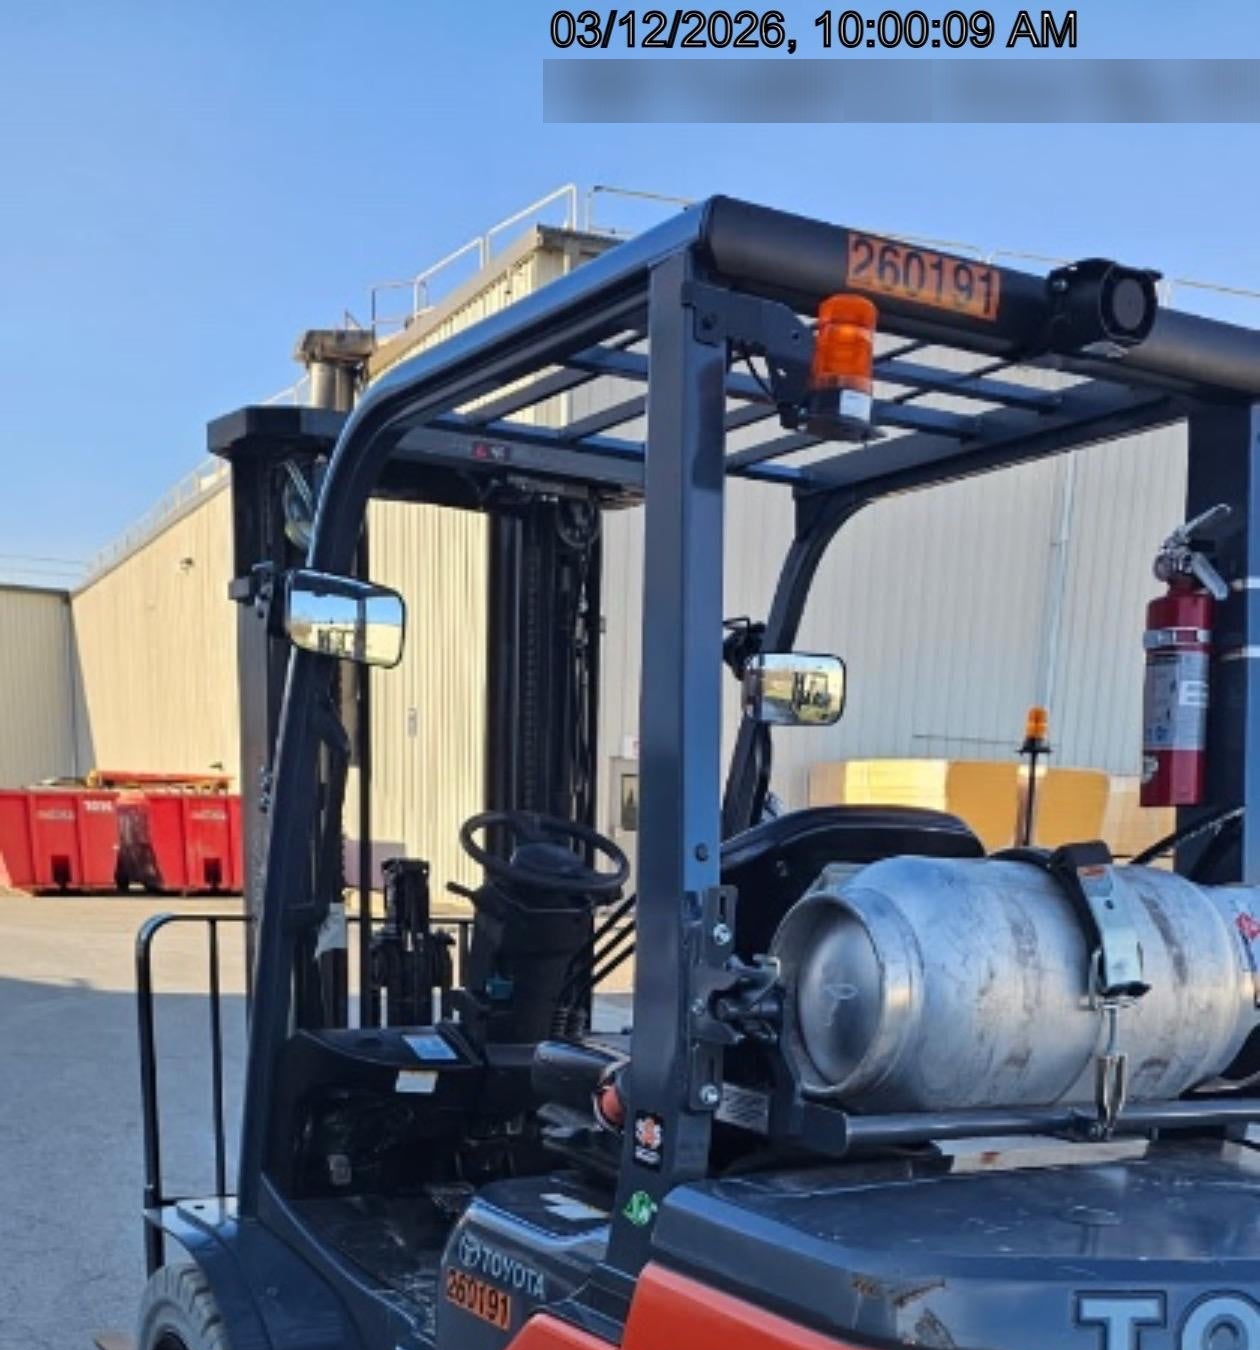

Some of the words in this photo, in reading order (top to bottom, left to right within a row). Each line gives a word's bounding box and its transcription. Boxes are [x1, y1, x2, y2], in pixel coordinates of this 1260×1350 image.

[848, 236, 993, 315] 260191
[447, 1268, 509, 1326] 260191
[481, 1243, 546, 1302] TOYOTA
